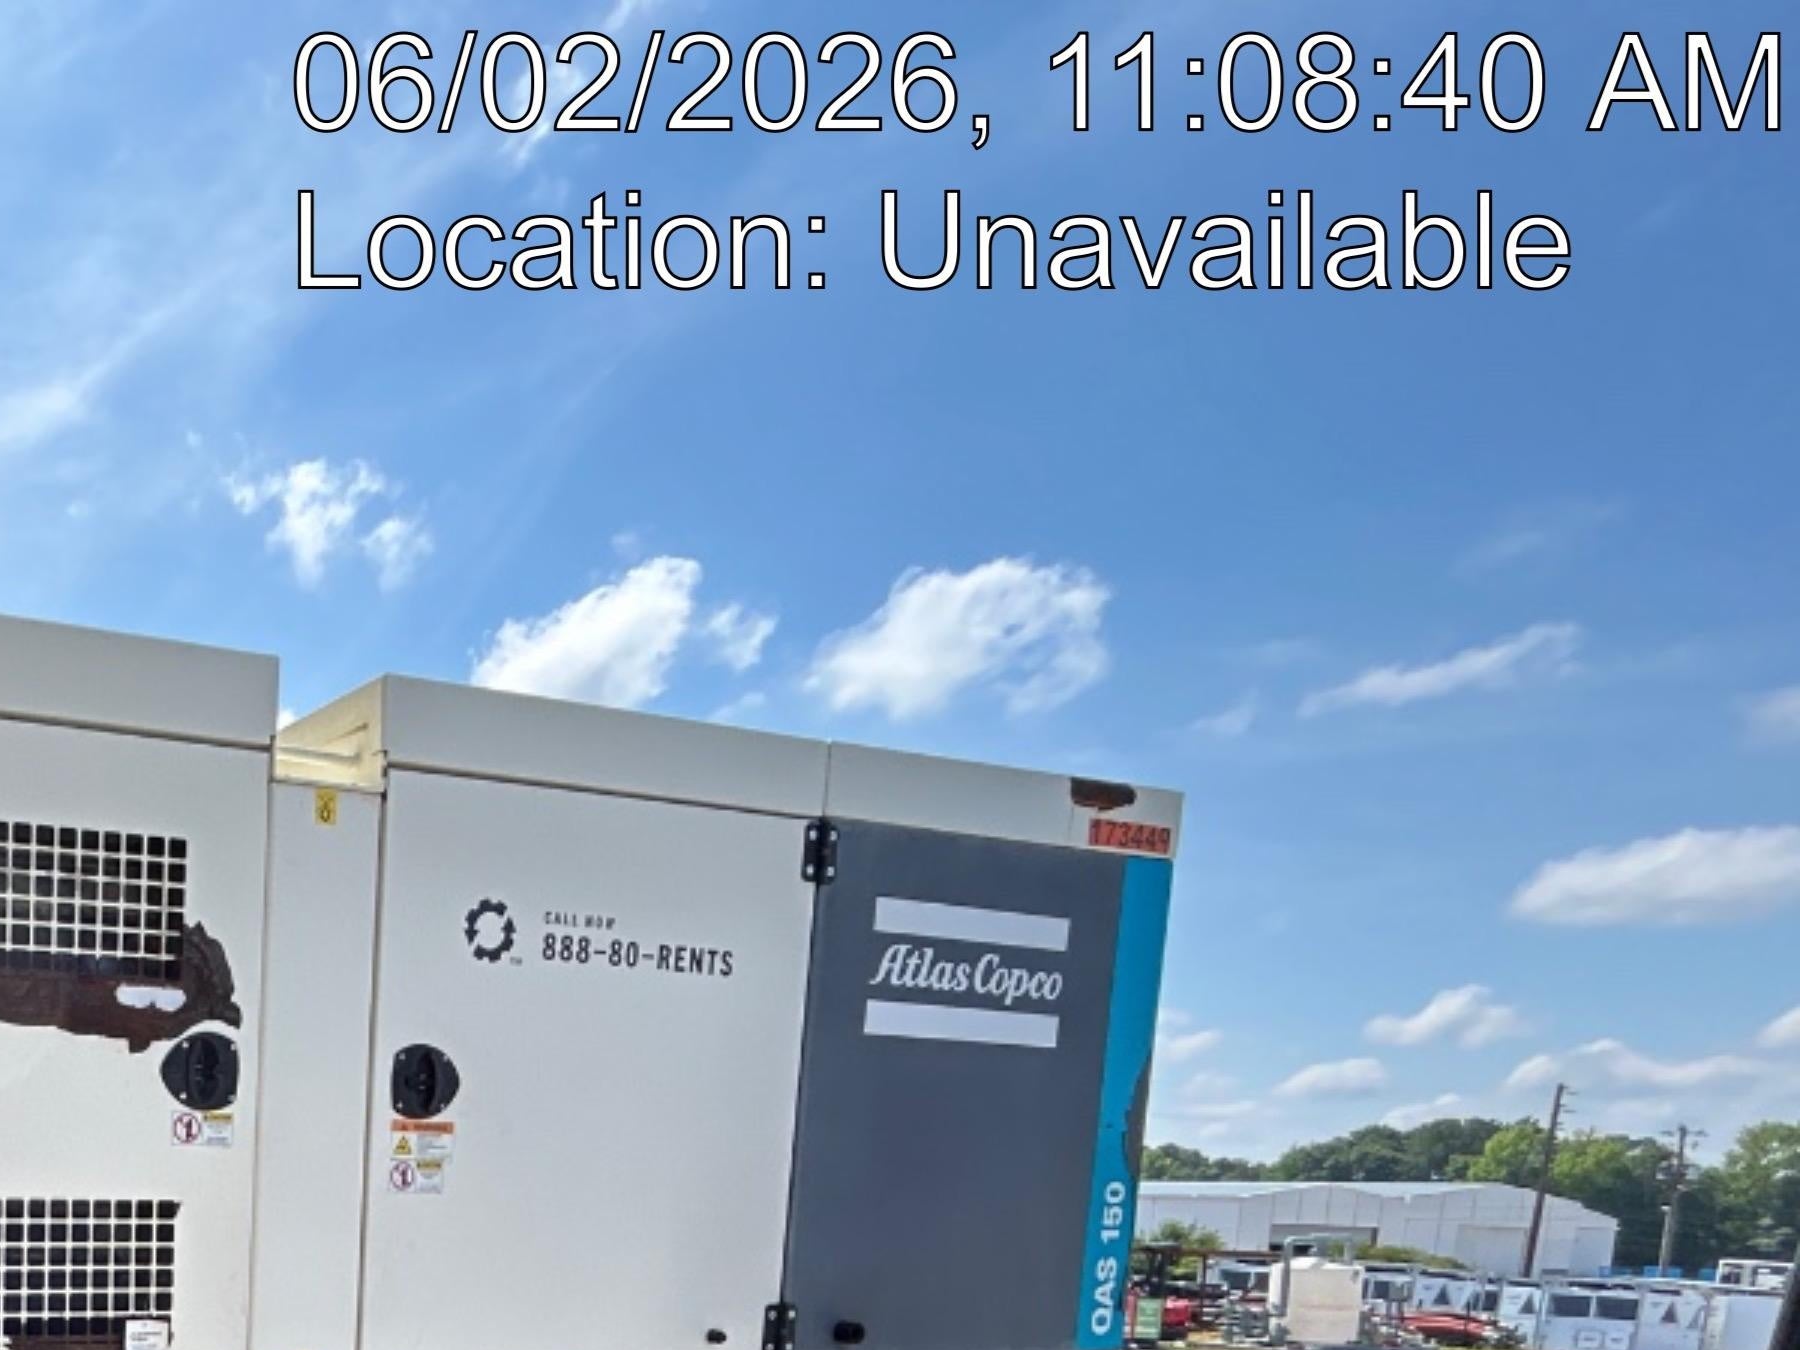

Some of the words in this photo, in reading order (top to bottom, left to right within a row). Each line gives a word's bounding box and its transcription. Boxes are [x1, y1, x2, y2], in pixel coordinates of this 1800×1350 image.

[544, 911, 578, 928] CALL
[584, 915, 616, 930] NOW
[542, 932, 733, 977] 888-80-RENTS
[869, 944, 970, 991] Atlas
[973, 953, 1063, 1006] Copco
[1100, 1181, 1126, 1246] 150
[1091, 1256, 1117, 1335] QAS
